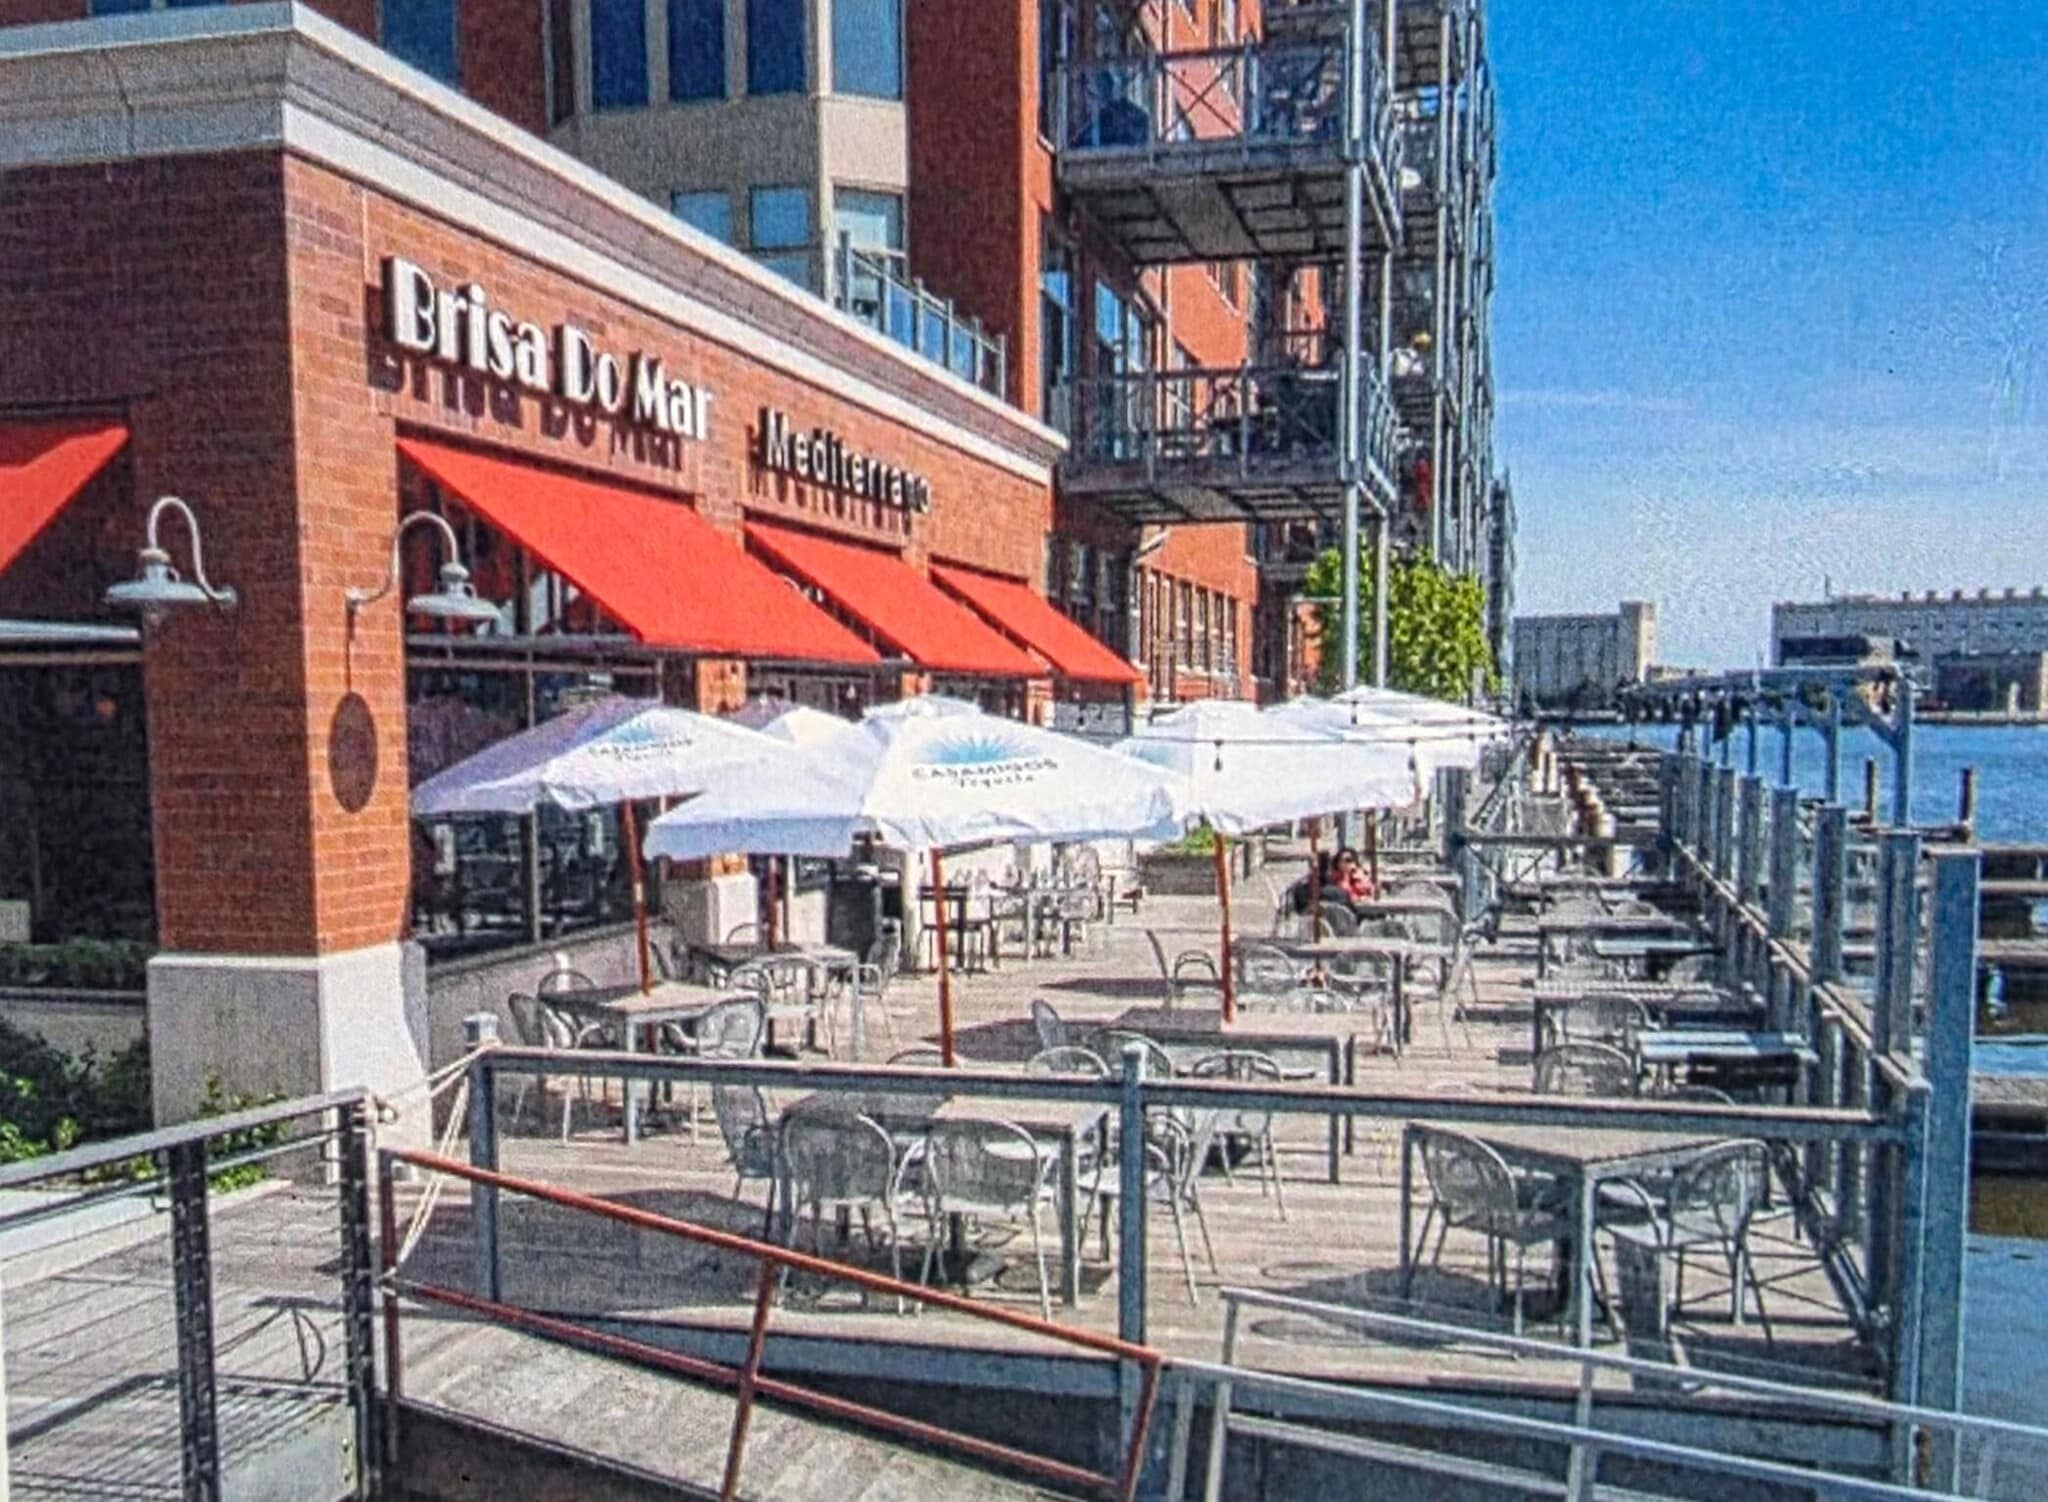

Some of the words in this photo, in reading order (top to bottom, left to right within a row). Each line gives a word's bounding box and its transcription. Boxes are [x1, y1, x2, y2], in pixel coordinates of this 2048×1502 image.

[384, 256, 549, 392] Brisa
[555, 325, 621, 413] Do
[630, 350, 714, 440] Mar
